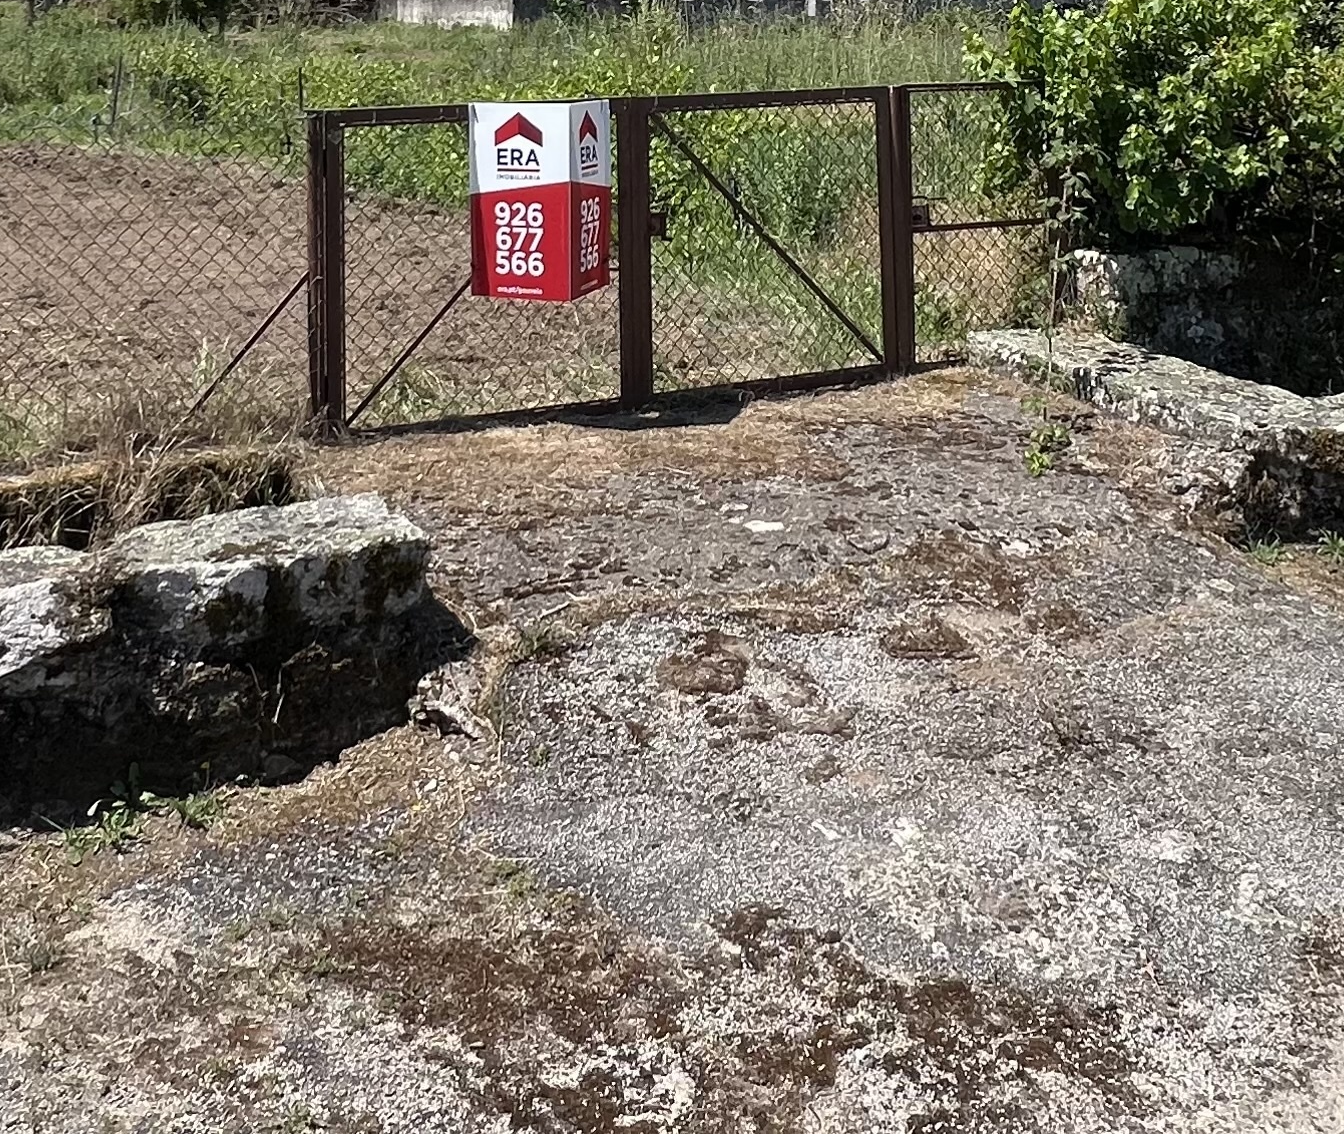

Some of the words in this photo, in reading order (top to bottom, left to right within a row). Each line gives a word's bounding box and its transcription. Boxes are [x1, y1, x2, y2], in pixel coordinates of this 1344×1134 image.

[497, 148, 540, 166] ERA
[580, 145, 598, 164] ERA
[494, 202, 543, 227] 926
[580, 197, 600, 224] 926
[496, 227, 544, 251] 677
[580, 221, 600, 248] 677
[495, 251, 544, 277] 566
[580, 245, 599, 273] 566
